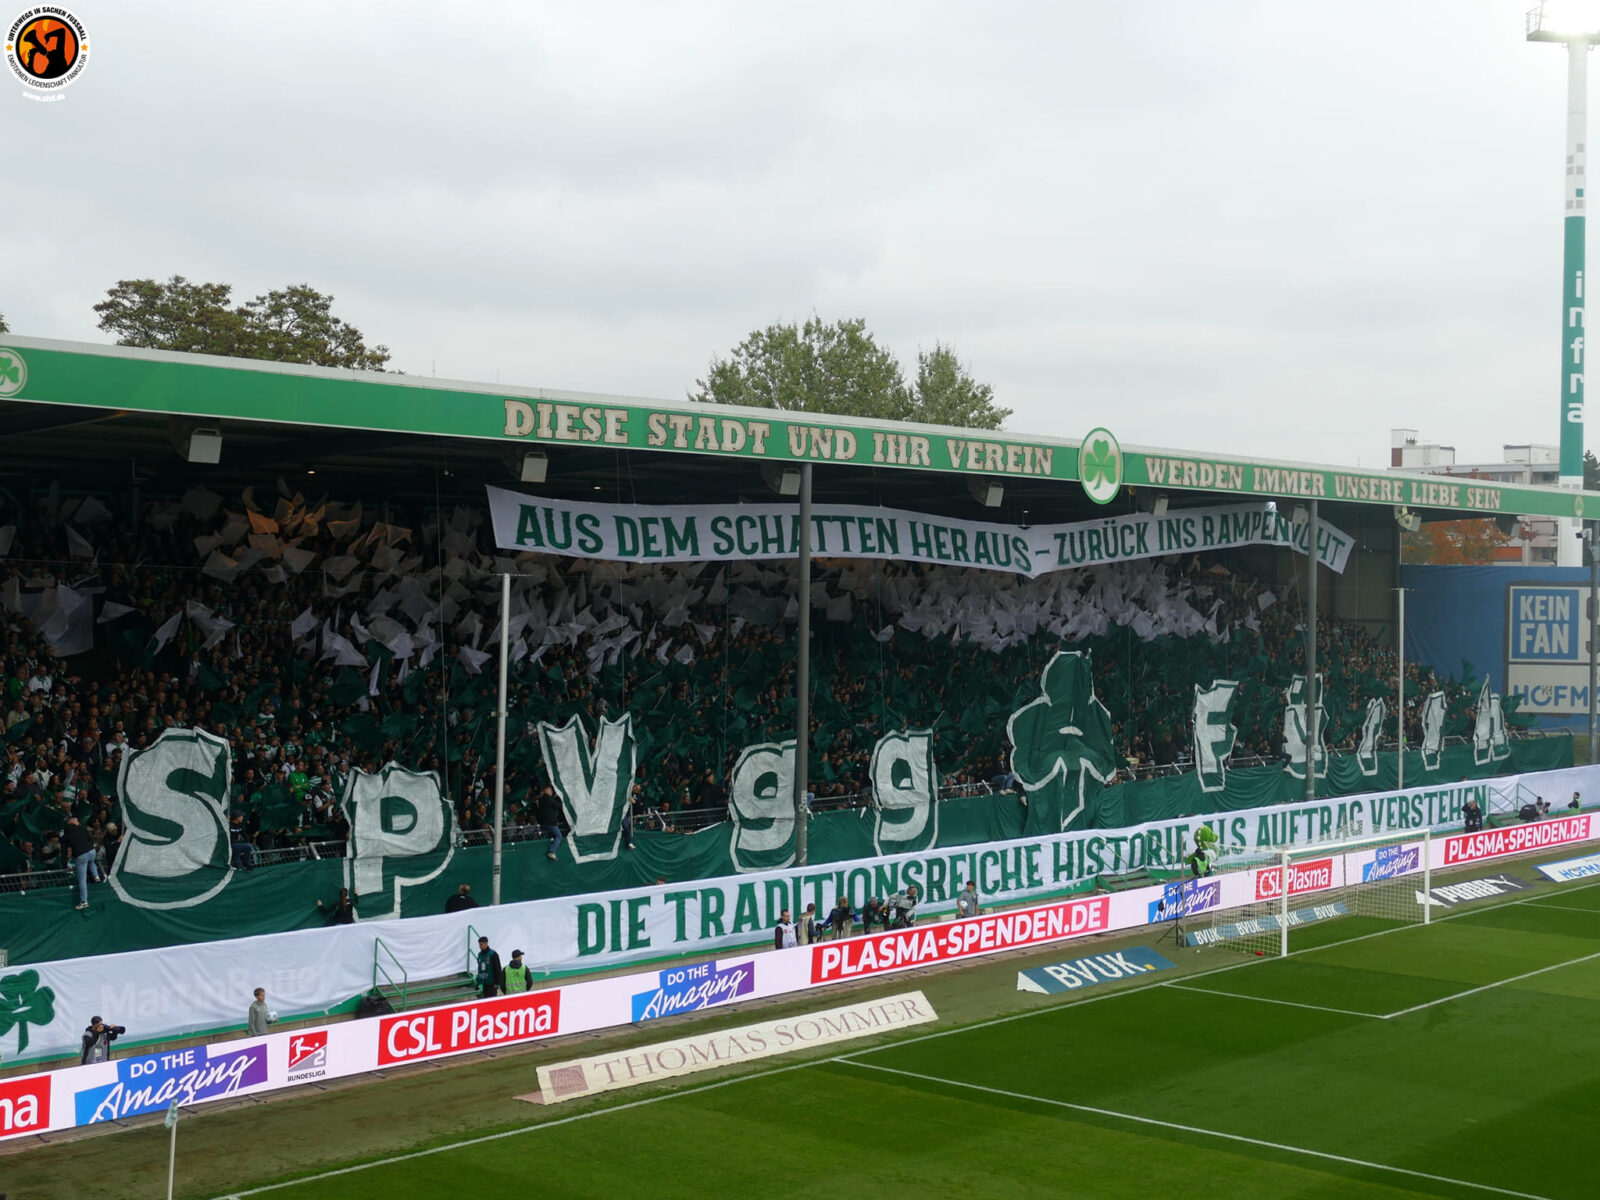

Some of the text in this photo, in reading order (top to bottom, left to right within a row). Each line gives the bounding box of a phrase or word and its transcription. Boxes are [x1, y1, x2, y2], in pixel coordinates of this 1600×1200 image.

[1567, 270, 1584, 423] infra
[503, 399, 1501, 510] DIESE STADT UND IHR VEREIN WERDEN IMMER UNSERE LIEBE SEIN
[514, 503, 604, 553] AUS
[612, 514, 701, 558] DEM
[710, 513, 900, 556] SCHATTEN
[908, 520, 1032, 572] HERAUS
[1053, 520, 1150, 566] ZURÜCK
[1157, 517, 1197, 551] INS
[1519, 595, 1570, 621] KEIN
[1519, 623, 1570, 654] FAN
[1513, 684, 1600, 707] HOFM
[1378, 846, 1400, 860] DO THE
[1448, 818, 1587, 862] PLASMA-SPENDEN.DE
[576, 896, 651, 957] DIE
[663, 843, 1044, 943] TRADITIONSREICHE
[1052, 823, 1191, 884] HISTORIE
[1256, 799, 1363, 853] AUFTRAG
[1259, 867, 1330, 897] CSL Plasma
[1366, 851, 1417, 883] Amazing
[1312, 903, 1342, 920] BVUK.
[820, 901, 1102, 979] PLASMA-SPENDEN.DE
[1193, 927, 1225, 946] BVUK.
[1234, 919, 1266, 936] BVUK.
[667, 965, 709, 986] DO THE
[1043, 952, 1156, 989] BVUK.
[639, 968, 748, 1022] Amazing
[386, 1003, 552, 1059] CSL Plasma
[593, 1028, 768, 1085] THOMAS
[778, 998, 927, 1047] SOMMER
[130, 1050, 195, 1080] DO THE
[312, 1046, 326, 1067] 2
[88, 1053, 257, 1125] Amazing
[287, 1069, 327, 1083] BUNDESLIGA
